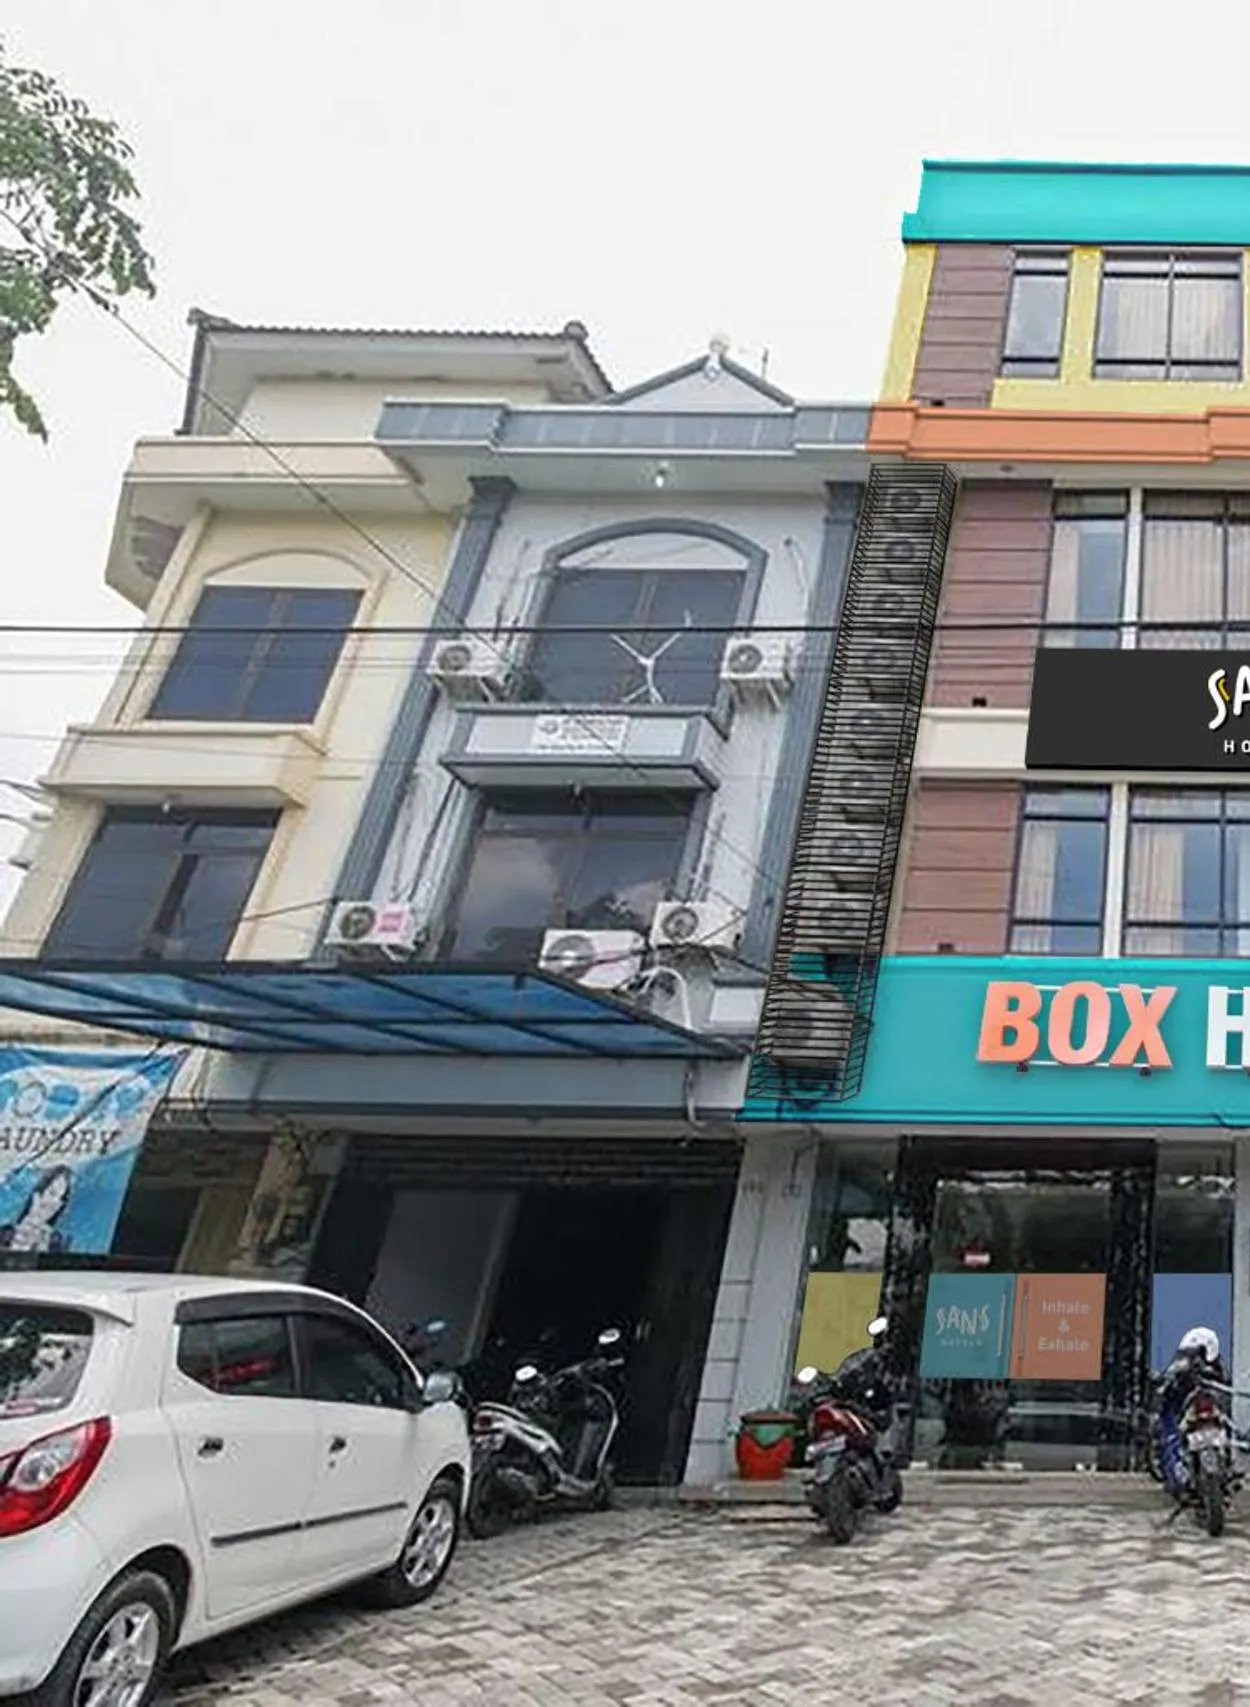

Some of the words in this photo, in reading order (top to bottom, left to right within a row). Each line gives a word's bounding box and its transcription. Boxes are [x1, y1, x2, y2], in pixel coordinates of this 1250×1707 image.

[976, 980, 1178, 1068] BOX
[1041, 1299, 1091, 1316] Inhale
[936, 1304, 990, 1335] SANS
[1057, 1319, 1071, 1334] &
[1037, 1336, 1090, 1352] Exhale
